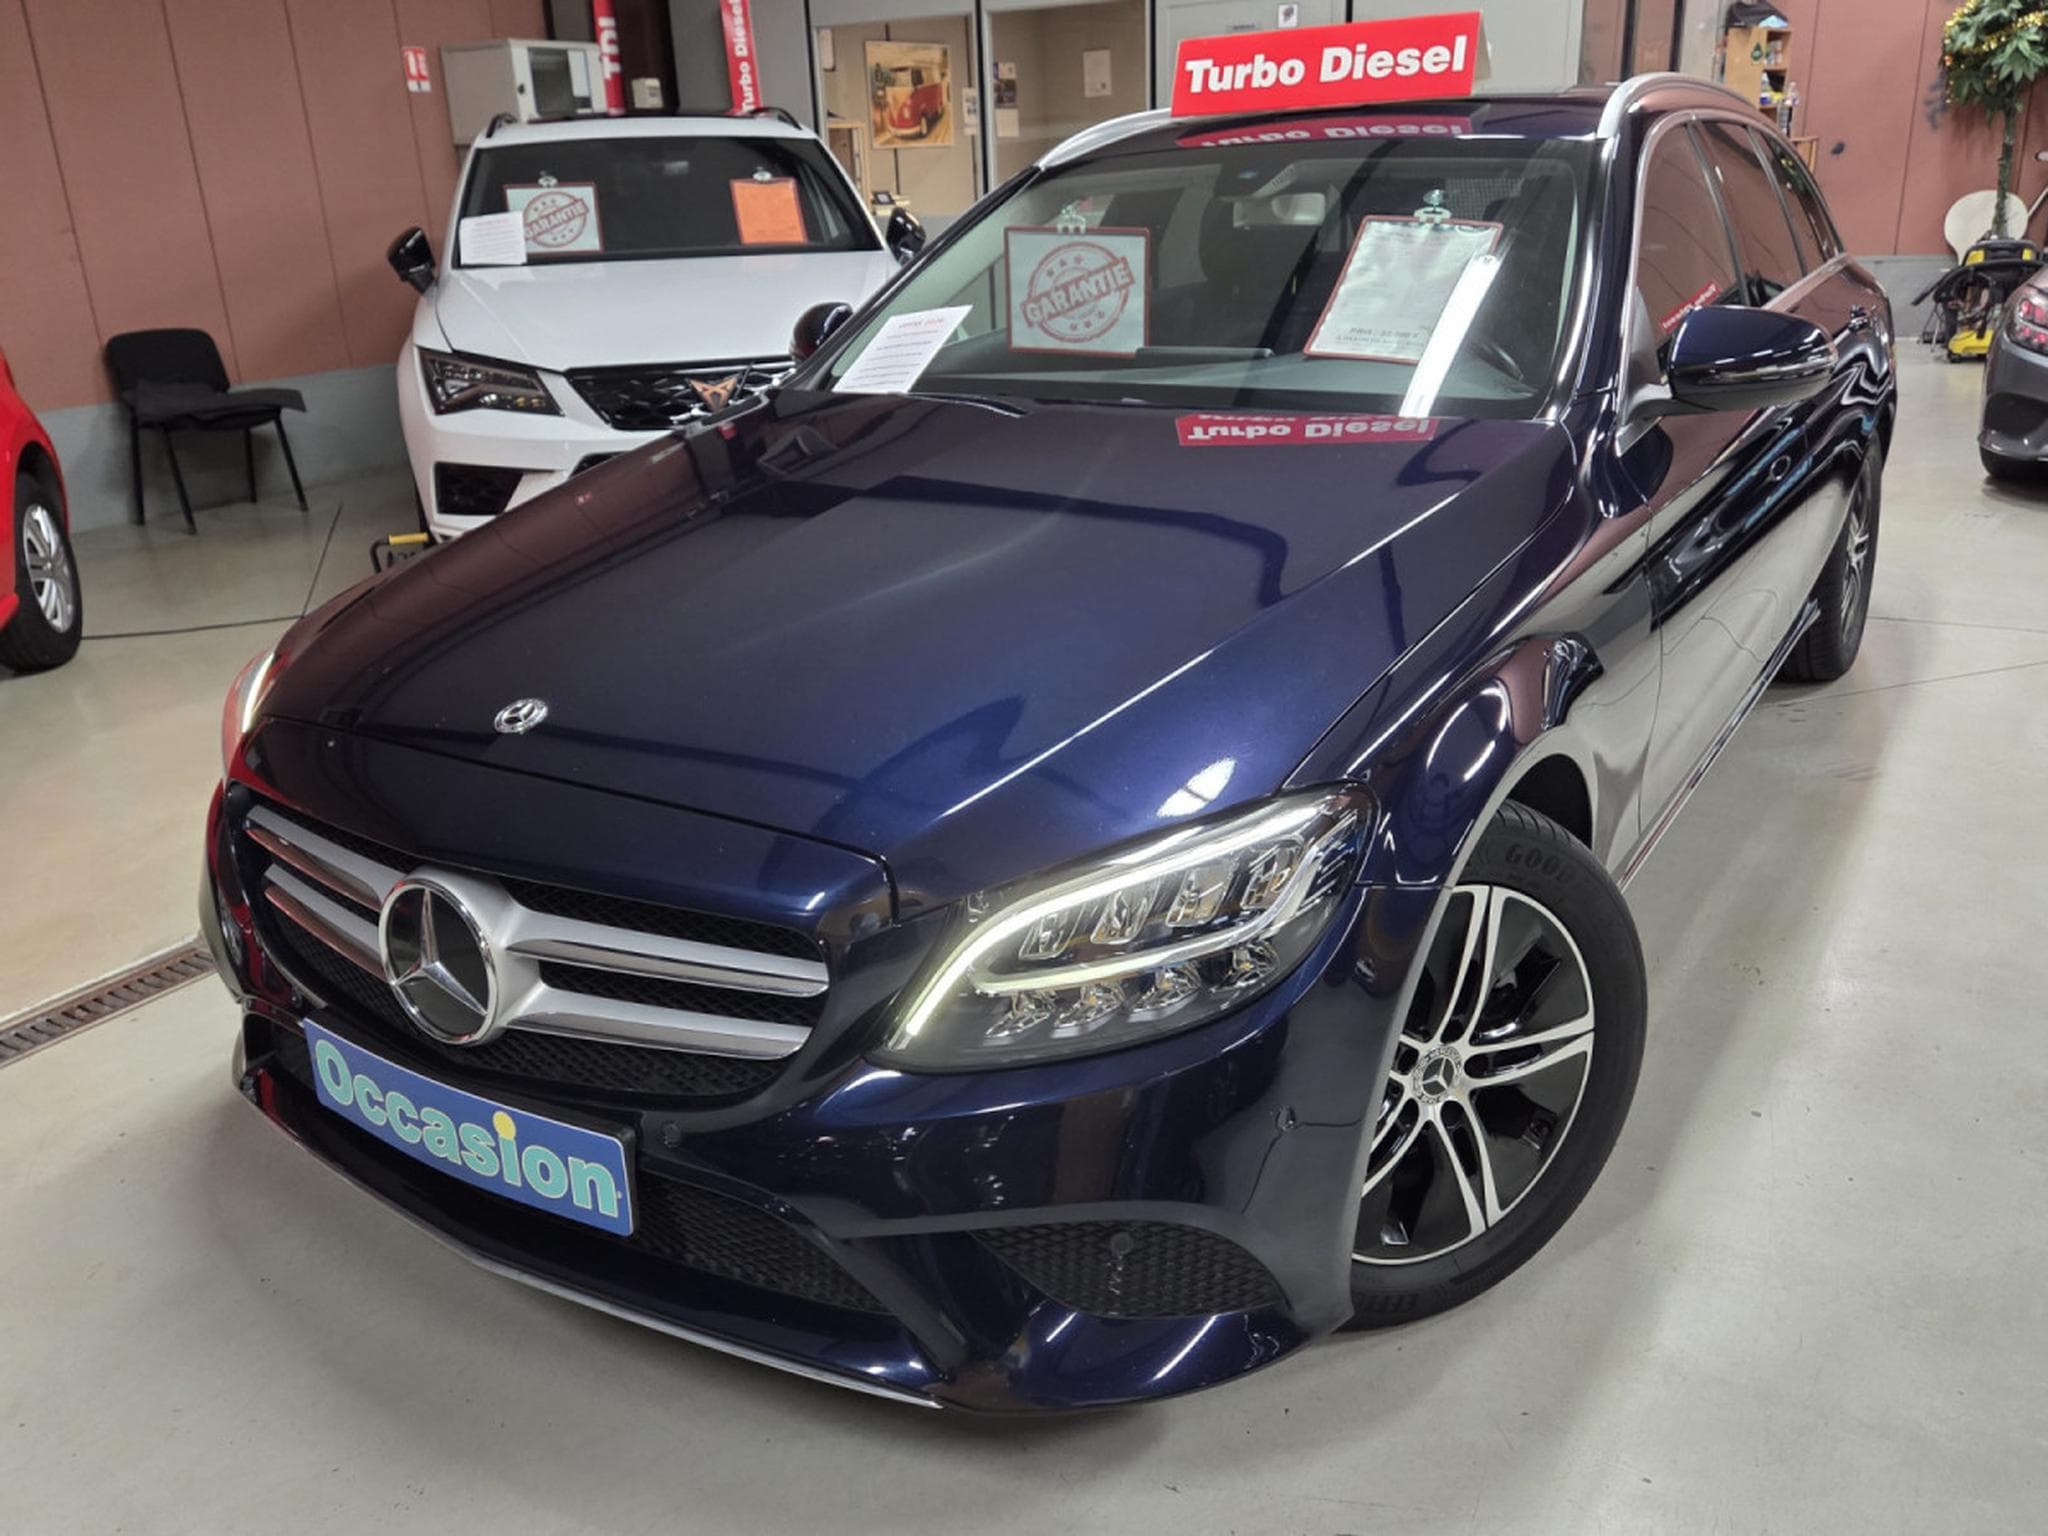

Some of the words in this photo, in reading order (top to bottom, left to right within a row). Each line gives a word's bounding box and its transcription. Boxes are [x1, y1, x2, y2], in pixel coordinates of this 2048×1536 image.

[598, 16, 621, 80] TDI
[1185, 54, 1306, 94] Turbo
[1320, 35, 1468, 83] Diesel
[738, 61, 756, 113] Turbo
[1025, 260, 1132, 323] GARANTIE
[315, 1039, 619, 1219] Occasion
